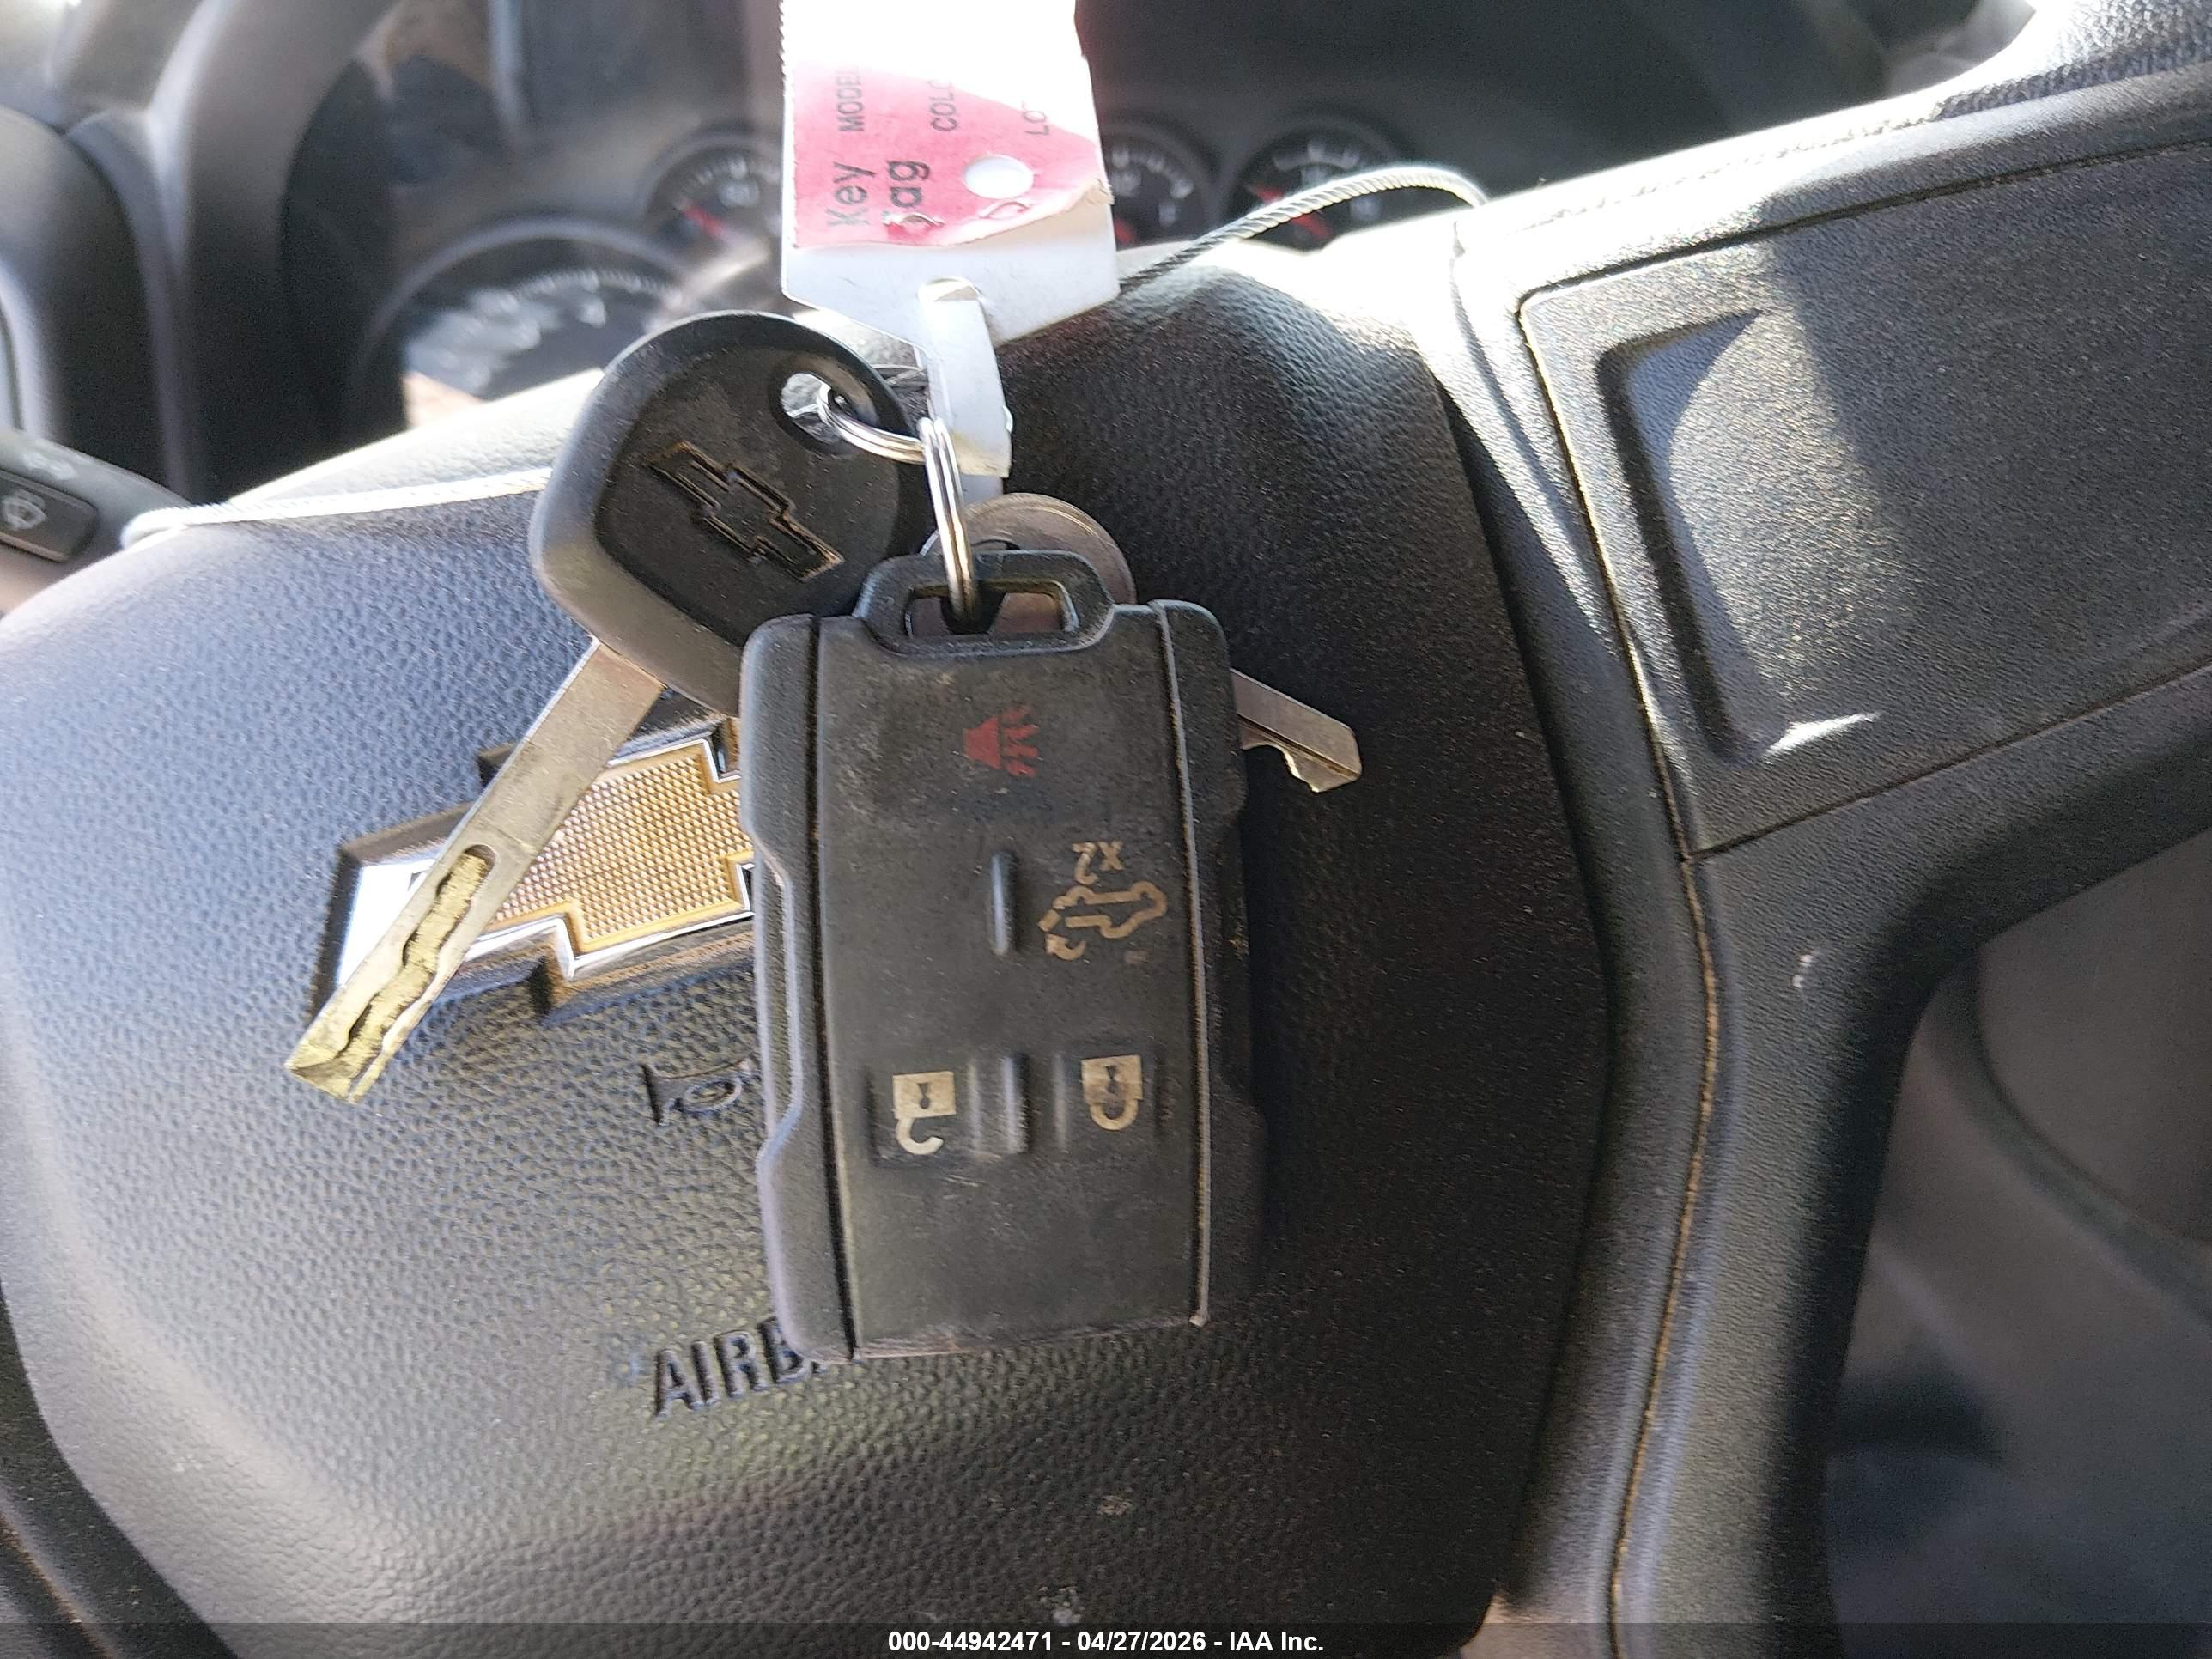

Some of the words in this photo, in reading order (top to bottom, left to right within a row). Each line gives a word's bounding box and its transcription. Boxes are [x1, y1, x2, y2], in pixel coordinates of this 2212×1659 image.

[826, 161, 877, 228] Key
[884, 159, 931, 215] ag
[654, 1316, 820, 1419] AIRB
